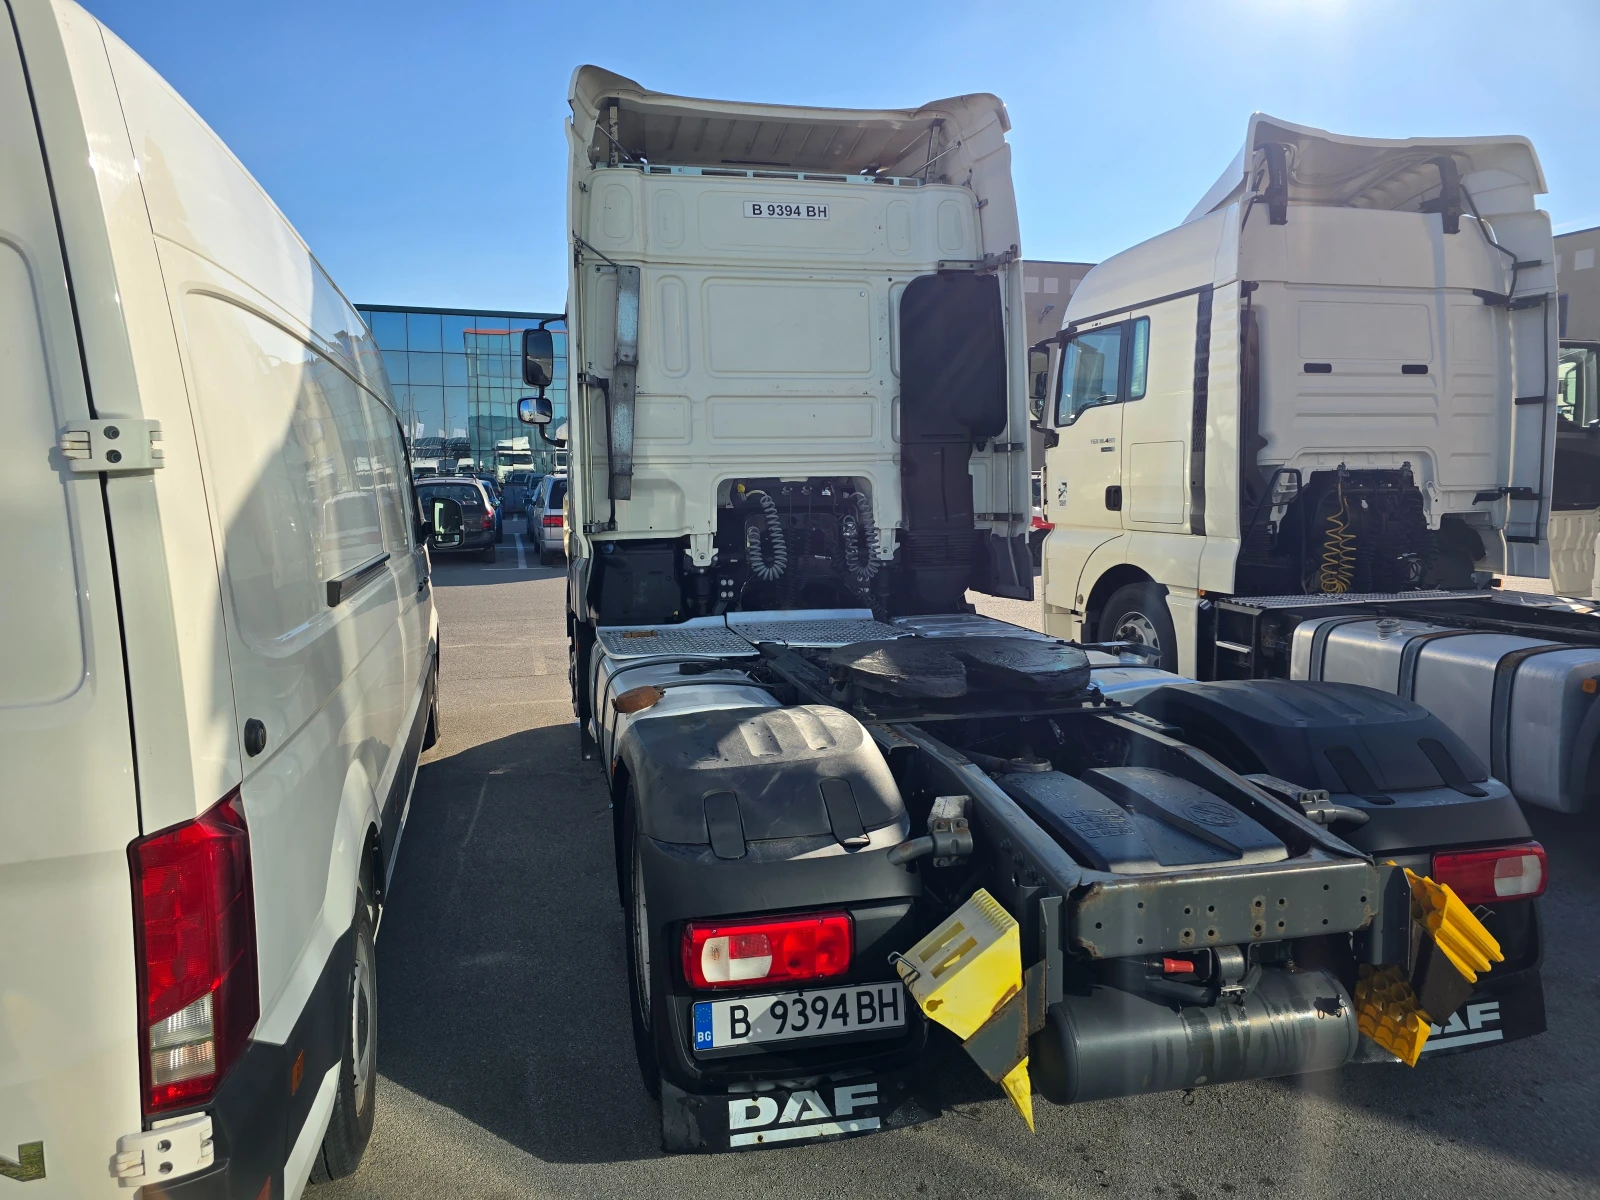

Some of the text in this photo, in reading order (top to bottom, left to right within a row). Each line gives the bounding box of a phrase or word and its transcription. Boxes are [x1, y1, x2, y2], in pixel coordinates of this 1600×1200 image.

[752, 204, 827, 217] B 9394 BH
[729, 988, 899, 1039] B 9394 BH
[1428, 1001, 1500, 1036] AF
[697, 1031, 712, 1042] BG
[728, 1083, 878, 1130] DAF
